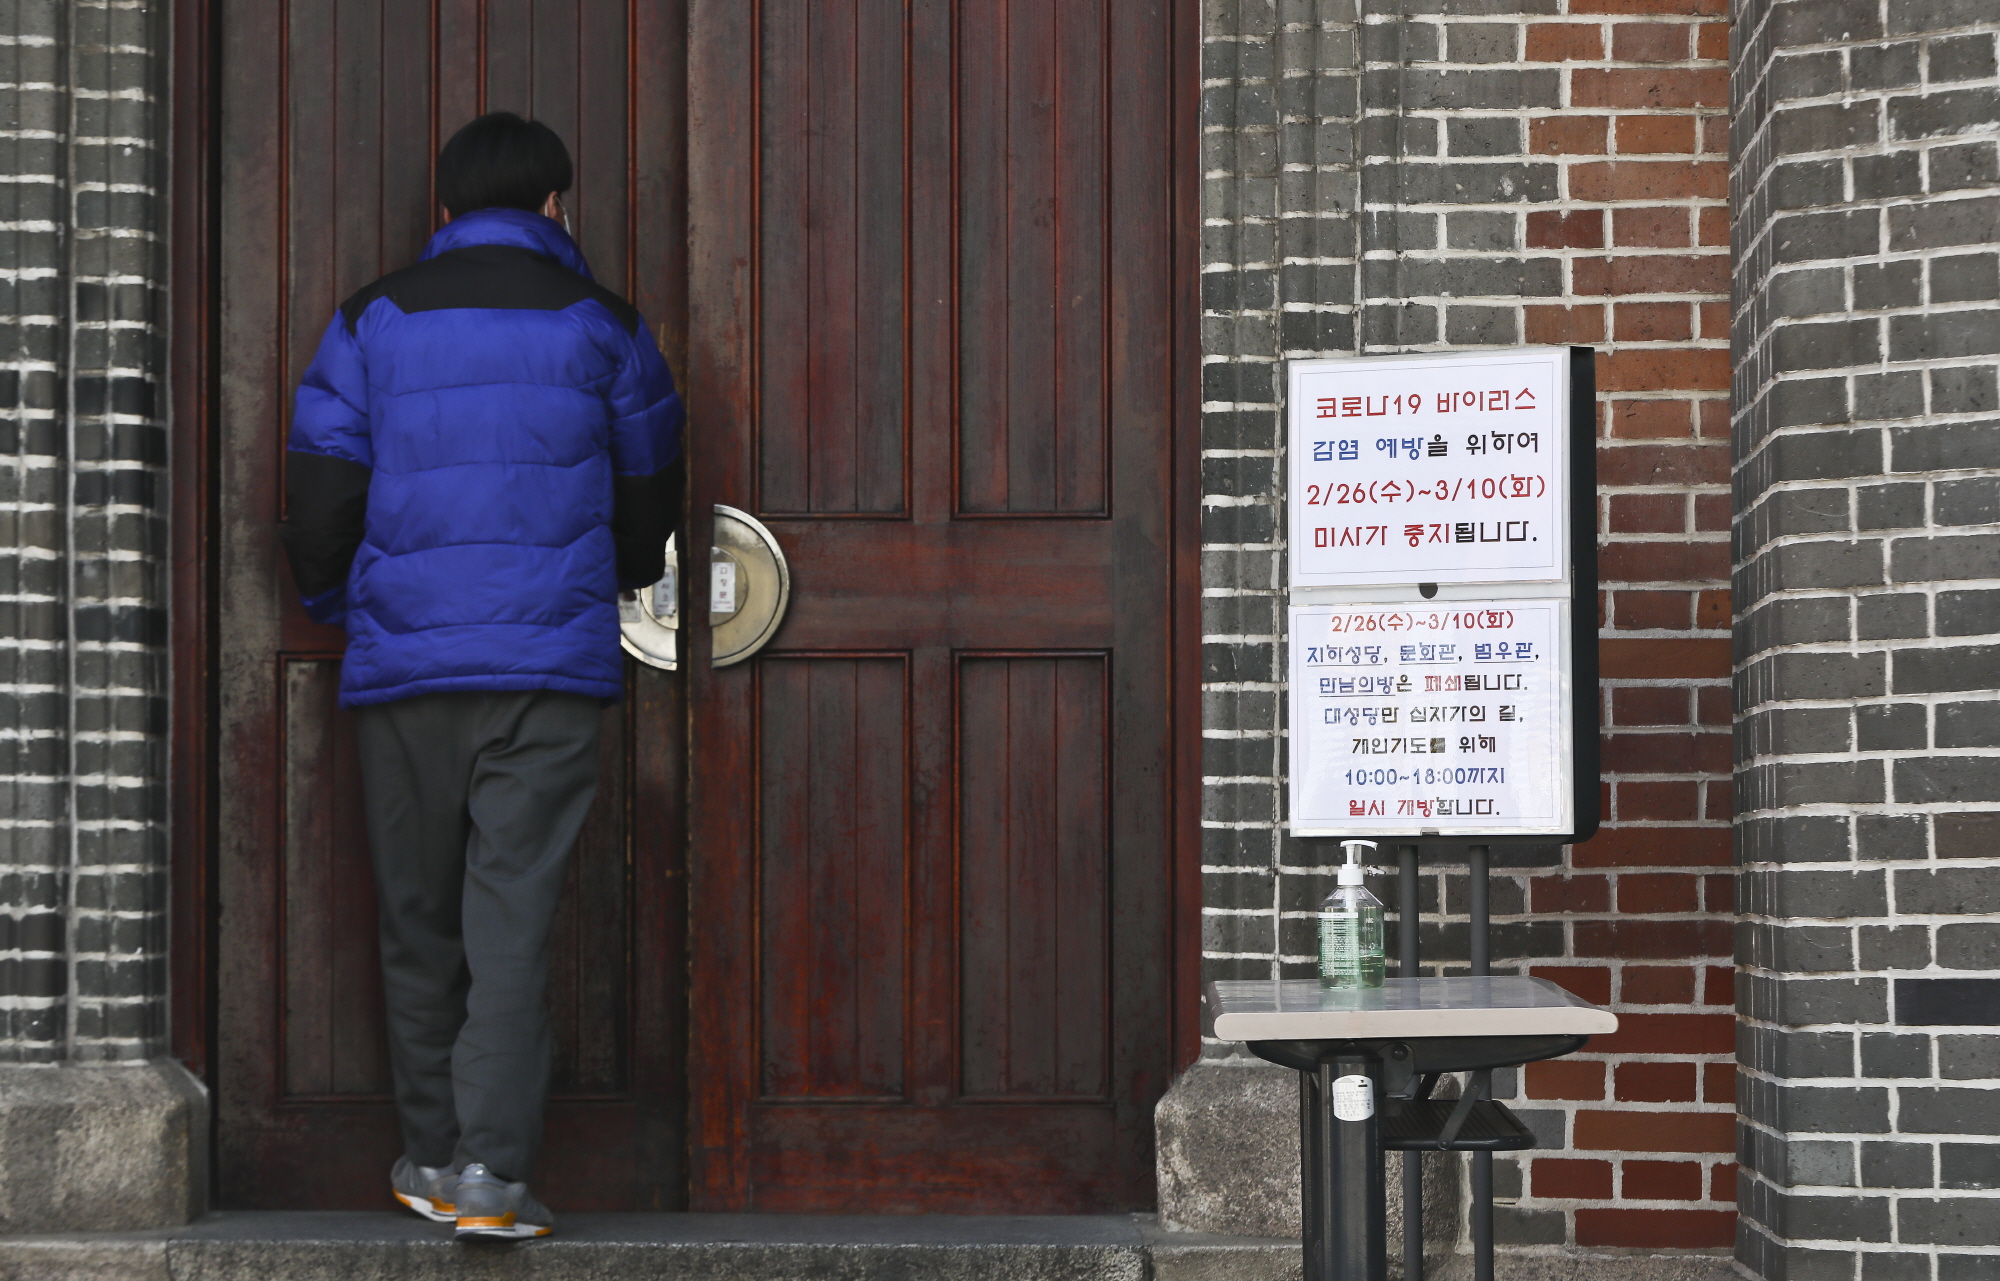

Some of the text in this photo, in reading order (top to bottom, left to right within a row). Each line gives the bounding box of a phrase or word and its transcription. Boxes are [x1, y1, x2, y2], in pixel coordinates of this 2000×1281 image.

[1317, 388, 1535, 418] 코로나19 바이러스
[1314, 431, 1538, 461] 감염 예방을 위하여
[1307, 474, 1545, 506] 2/26(수)~3/10(화)
[1315, 521, 1537, 547] 미사가 중지됩니다.
[1332, 610, 1513, 633] 2/26(수)~3/10(화)
[1307, 642, 1539, 664] 지하성당, 문화관, 범우관,
[1320, 674, 1527, 694] 만남의방은 폐쇄됩니다.
[1325, 705, 1523, 726] 대성당만 십자가의 길,
[1459, 734, 1495, 753] 위해
[1345, 768, 1504, 785] 10:00~18:00까지
[1349, 797, 1500, 817] 일시 개방합니다.
